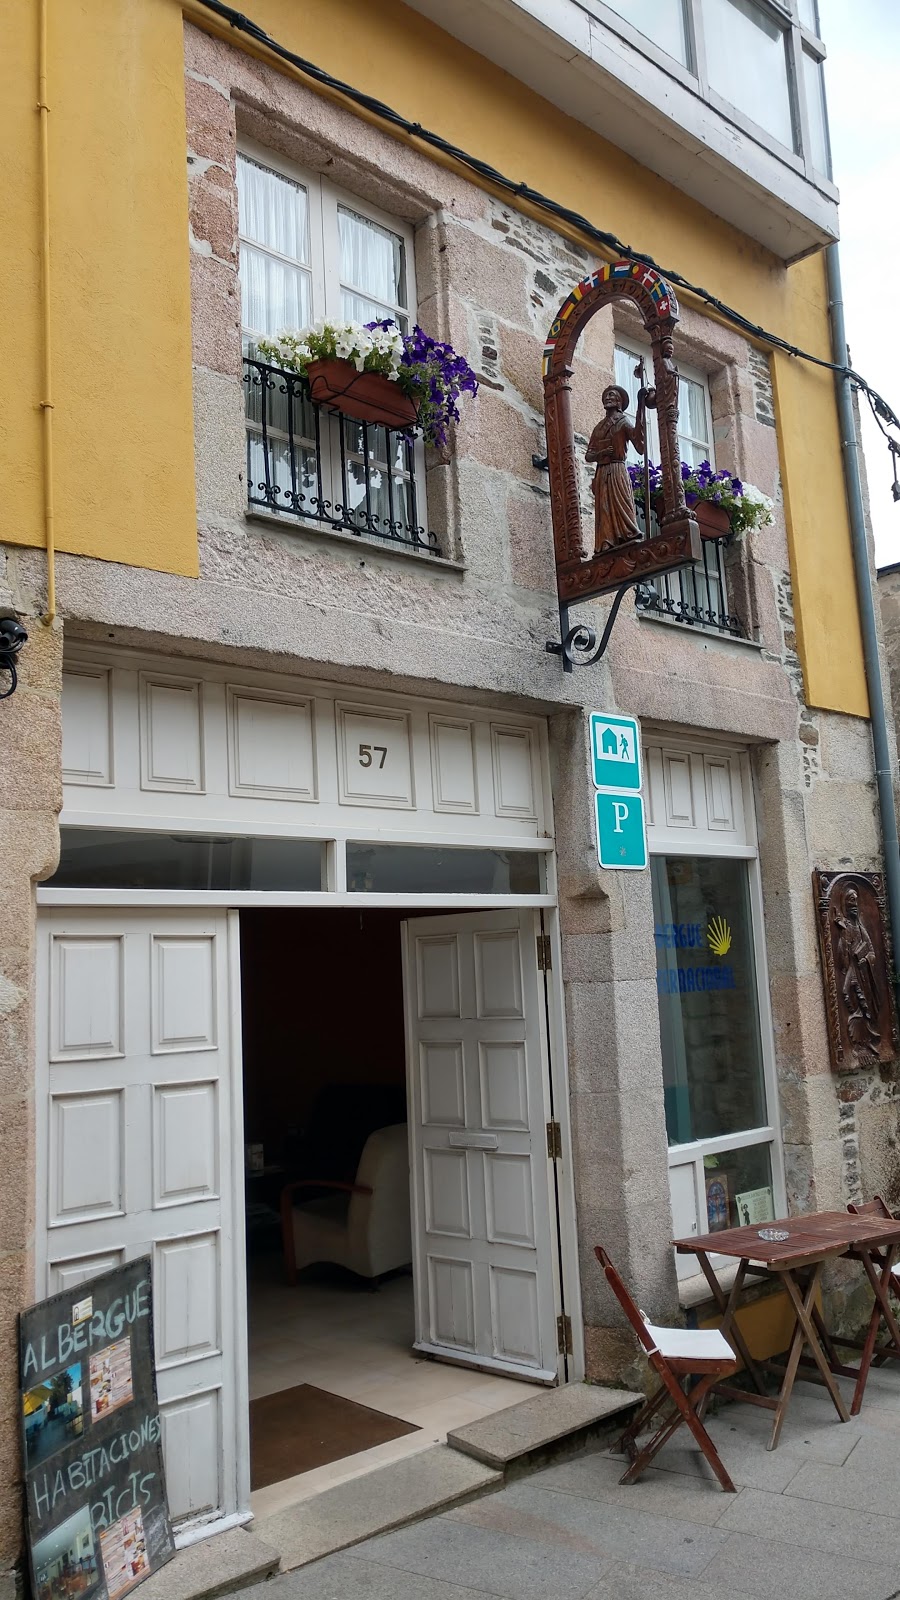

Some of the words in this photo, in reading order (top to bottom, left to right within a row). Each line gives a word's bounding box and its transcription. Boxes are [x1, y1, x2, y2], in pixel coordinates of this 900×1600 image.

[359, 744, 388, 769] 57
[612, 802, 629, 833] P
[23, 1280, 150, 1377] ALBERGUE
[33, 1415, 161, 1519] HABITACIONES
